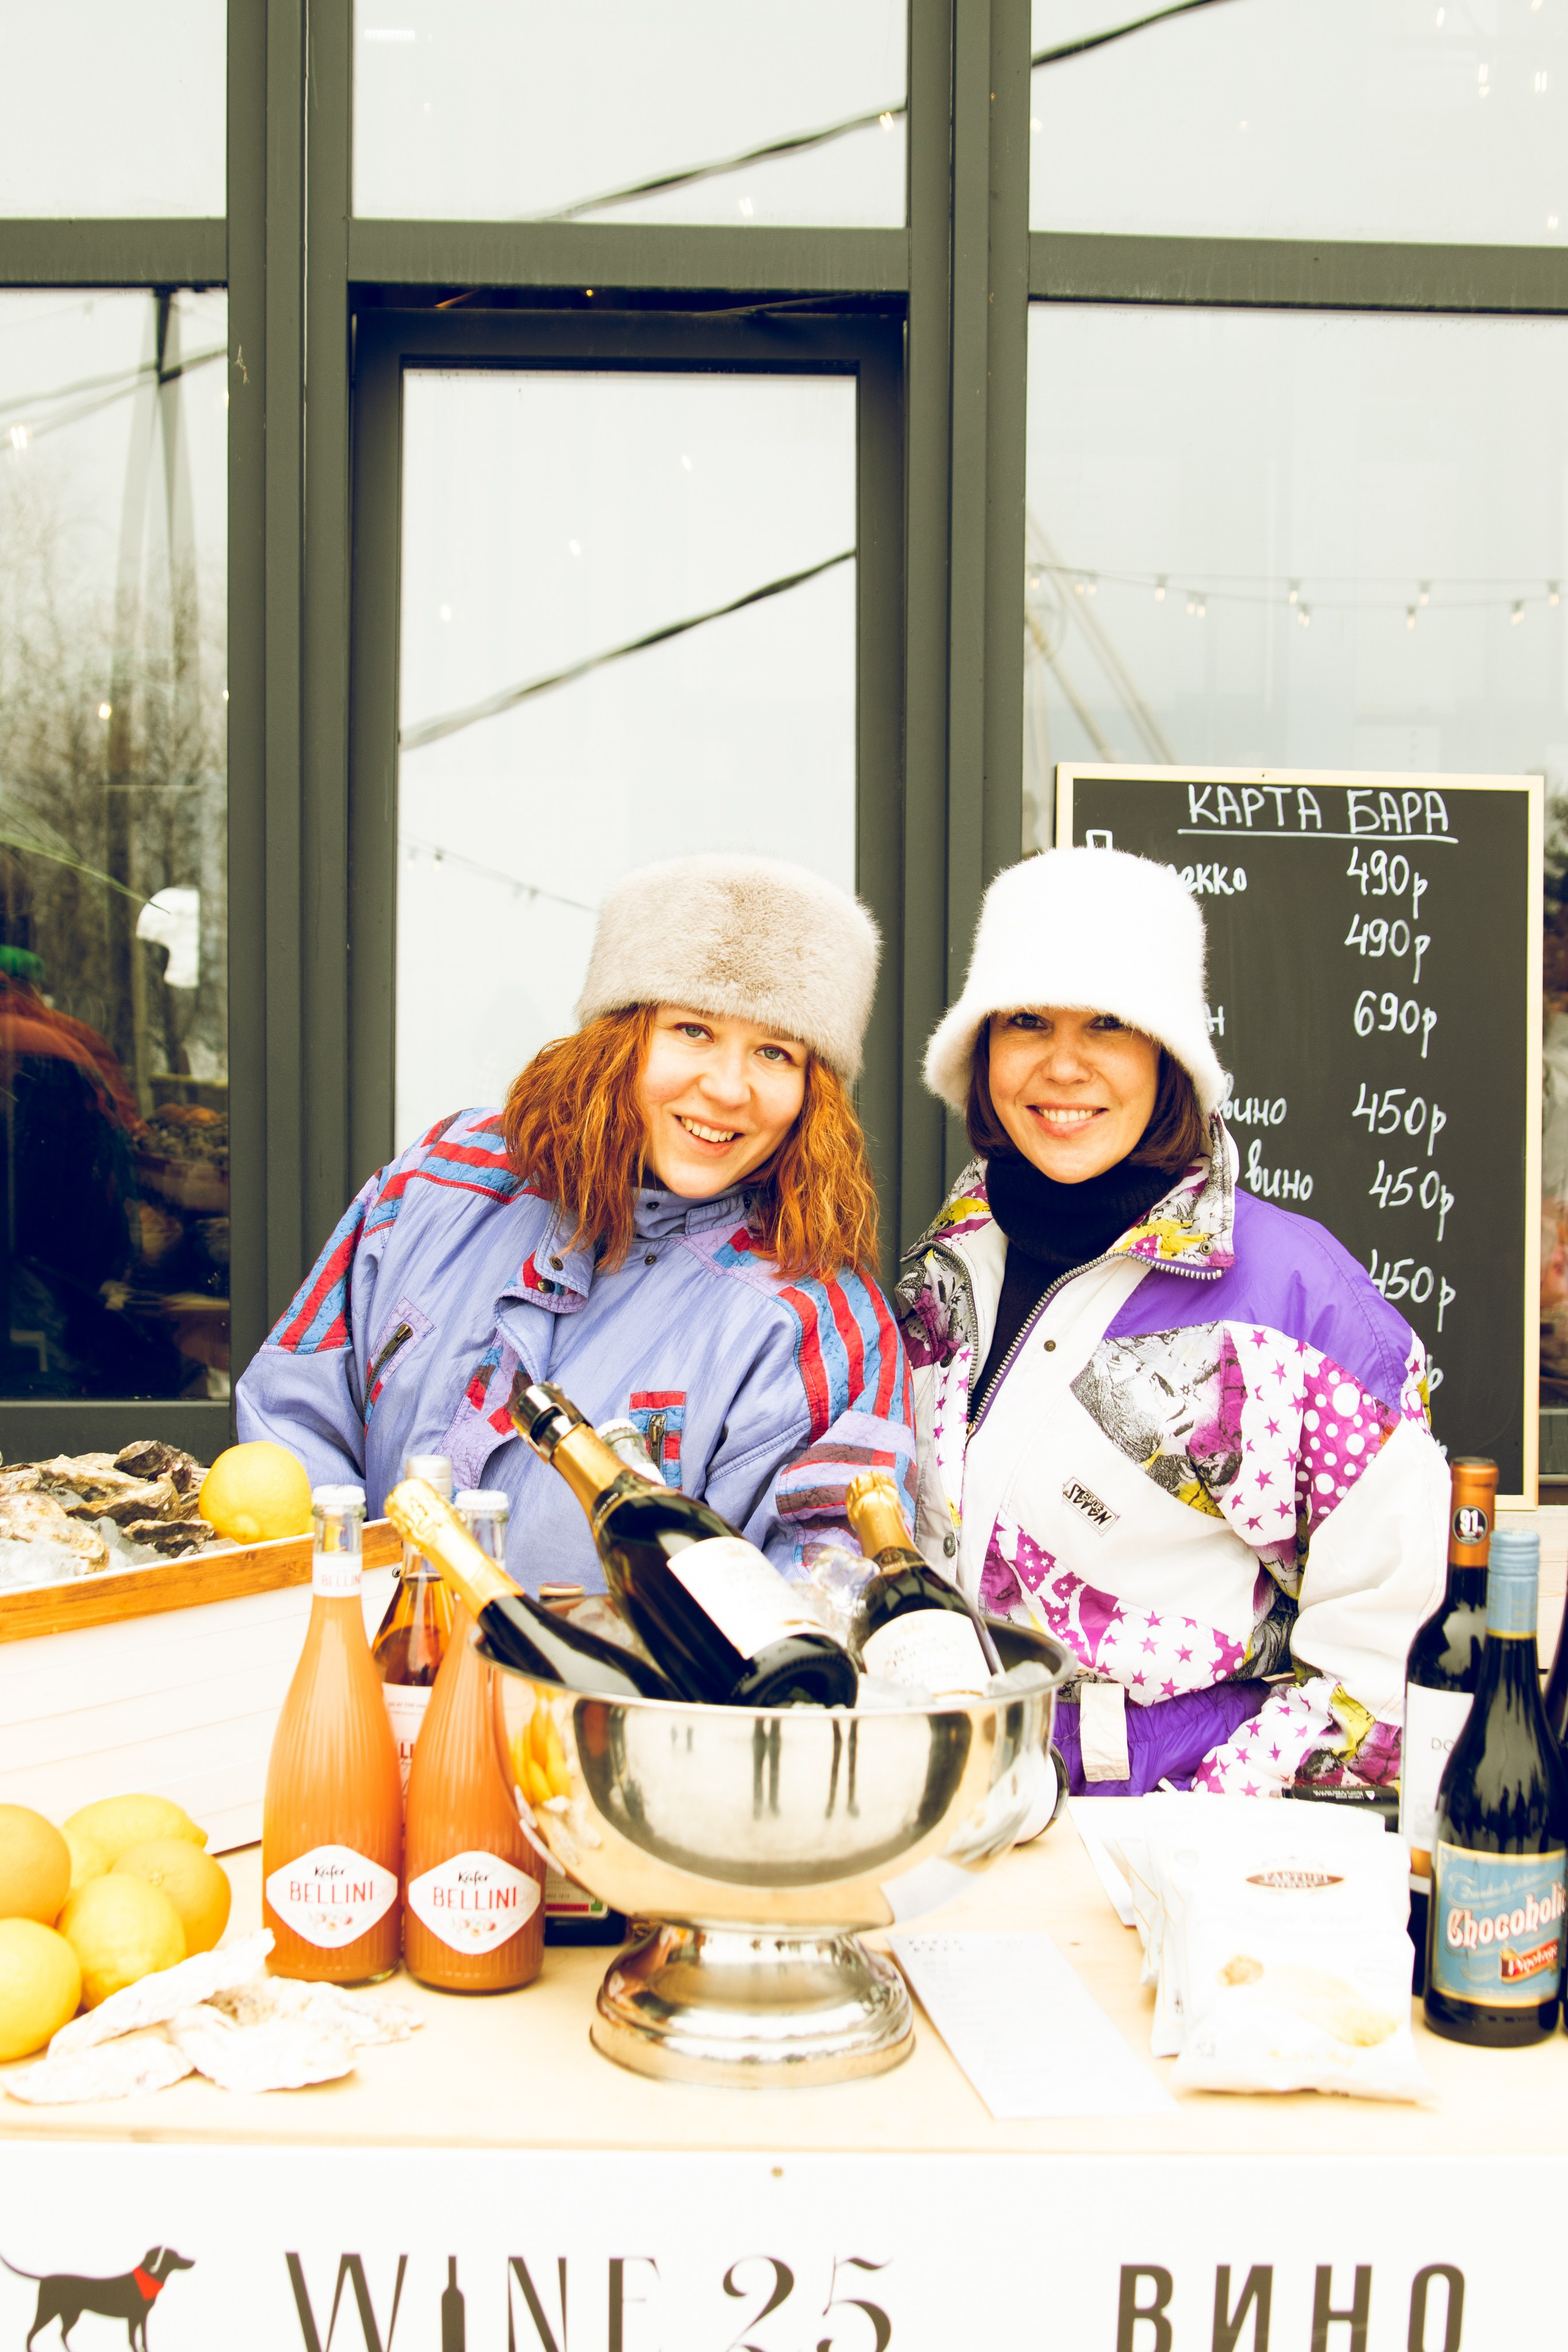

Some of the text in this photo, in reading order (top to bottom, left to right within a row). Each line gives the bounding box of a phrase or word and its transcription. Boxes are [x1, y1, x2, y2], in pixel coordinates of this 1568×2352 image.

[1188, 783, 1450, 834] КАРТА БАРА
[1346, 846, 1429, 920] 490р
[1344, 913, 1431, 984] 490р
[1354, 990, 1438, 1059] 690р
[1352, 1082, 1447, 1156] 450р
[1245, 1138, 1455, 1242] вино 450р
[1370, 1249, 1457, 1332] 450р
[290, 1880, 374, 1904] BELLINI
[433, 1885, 517, 1910] BELLINI
[722, 2255, 894, 2352] 25
[1116, 2264, 1466, 2352] ВИНО
